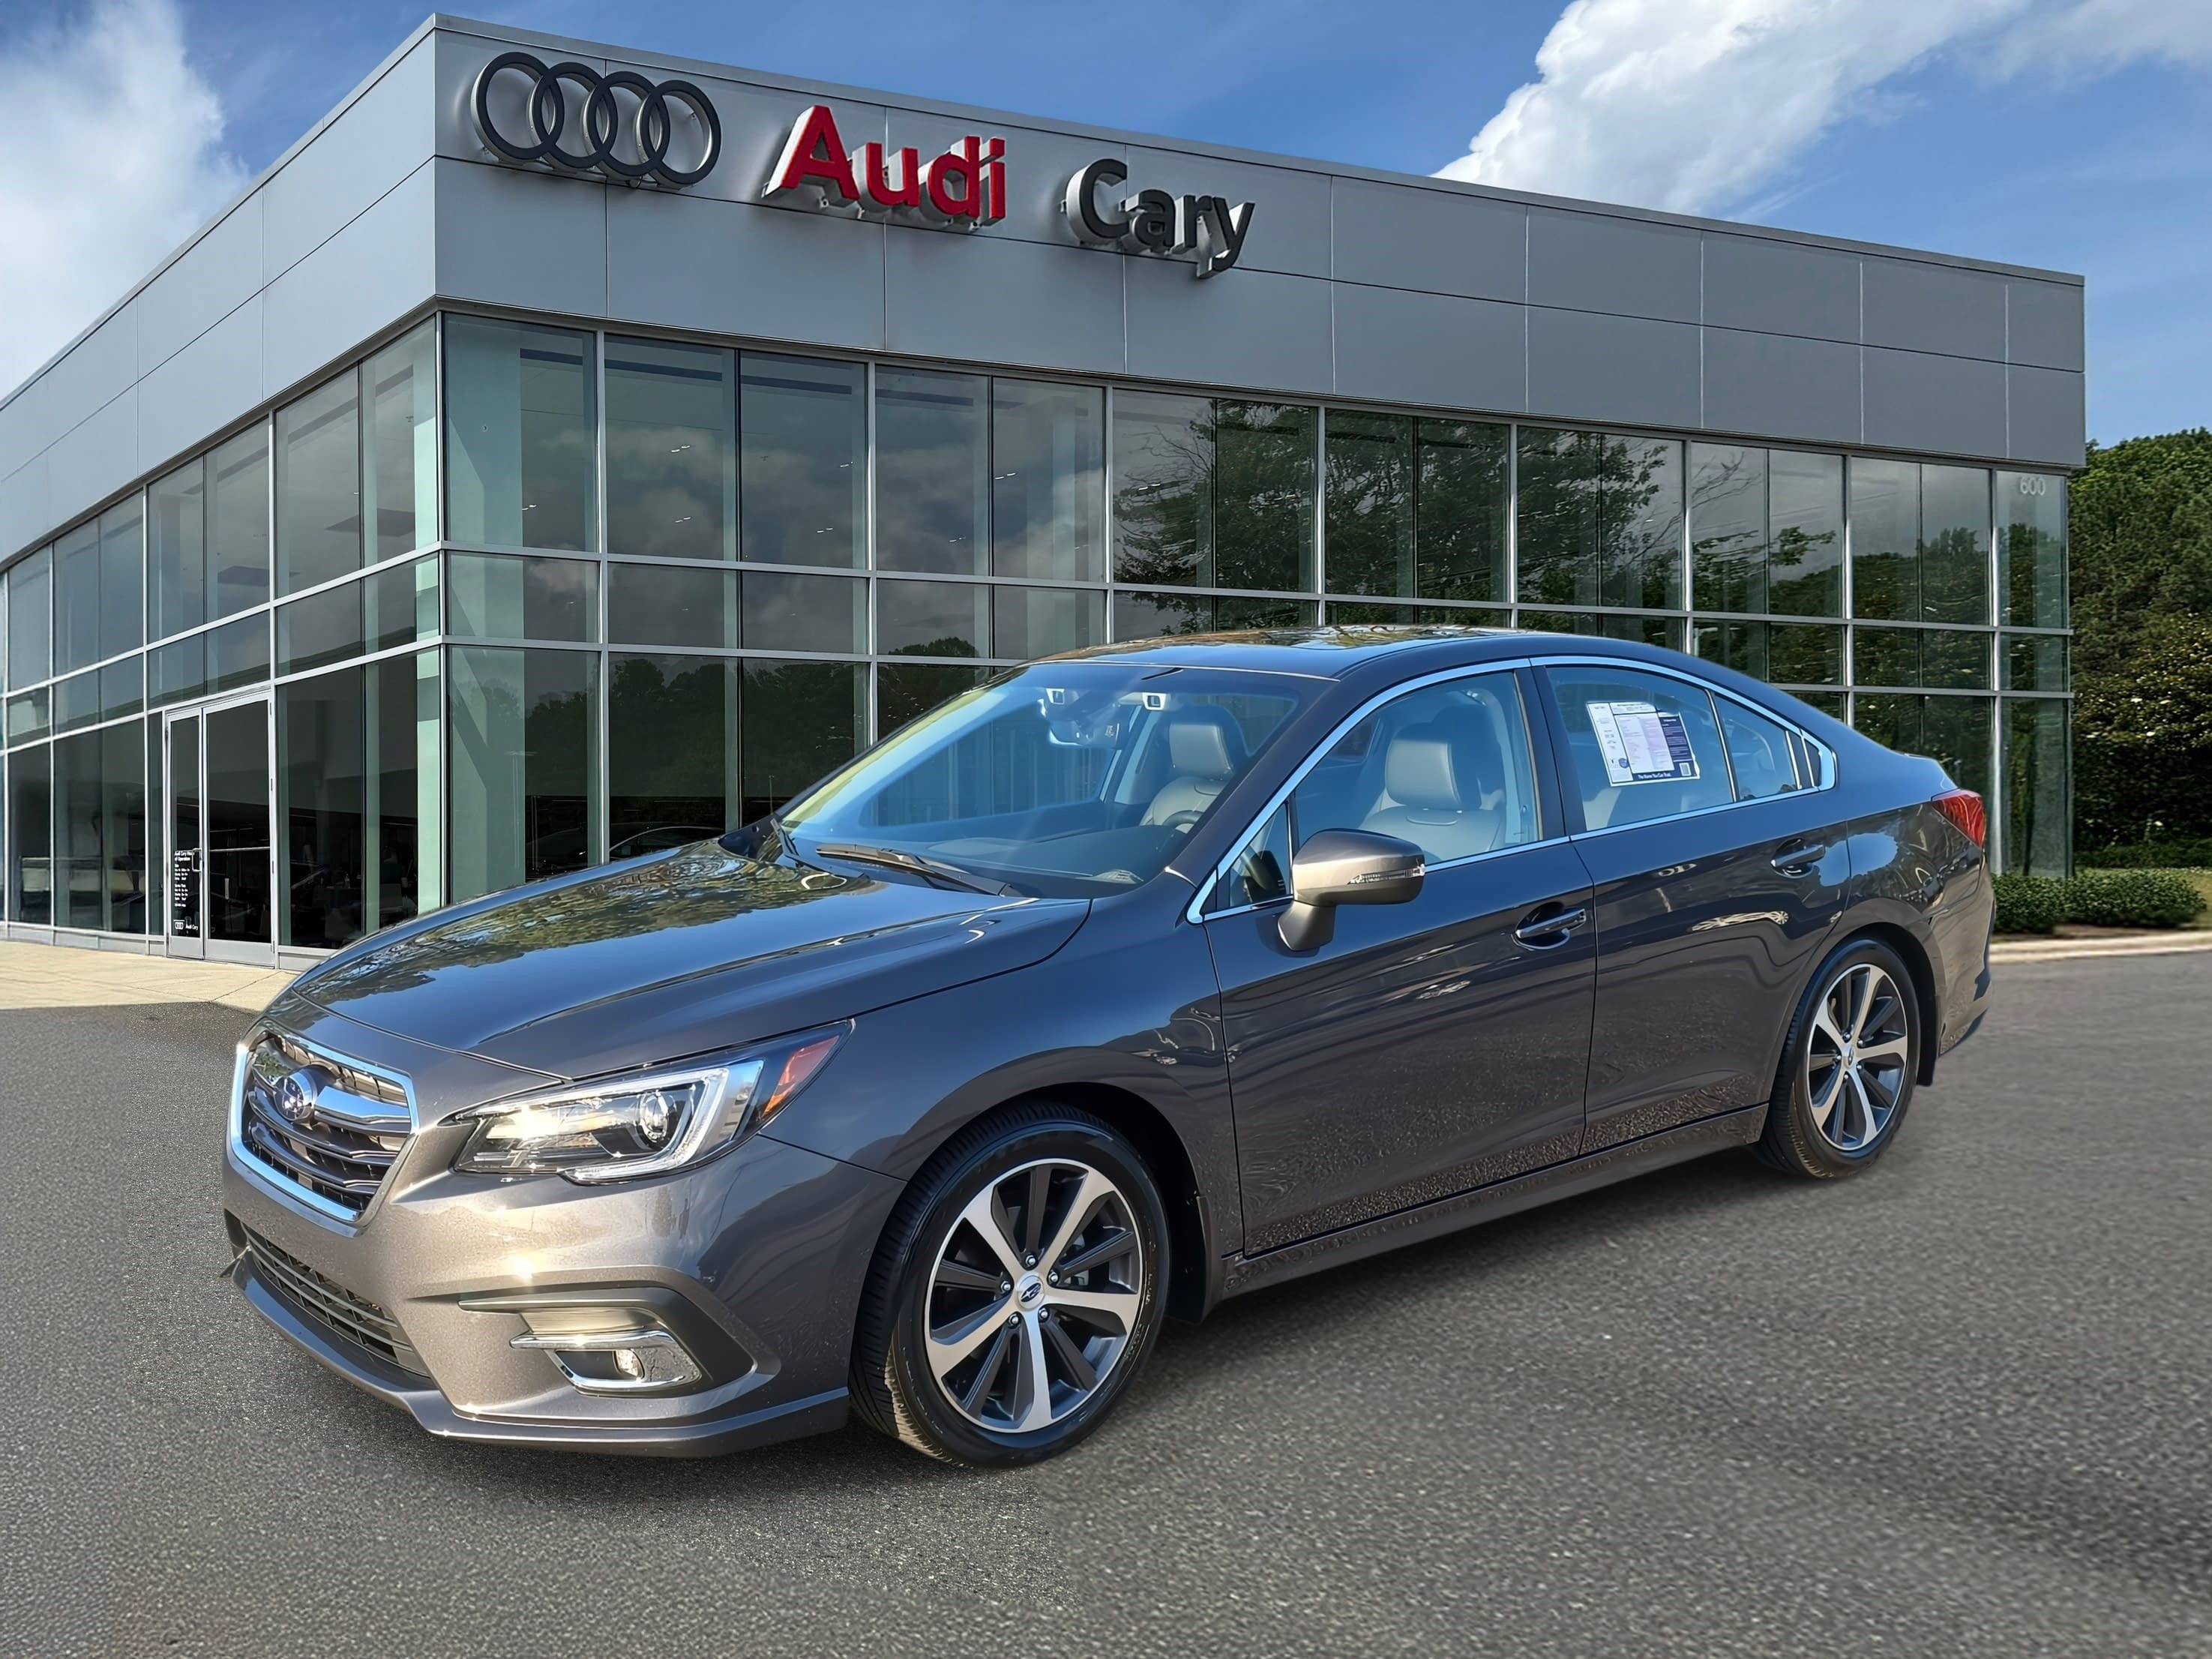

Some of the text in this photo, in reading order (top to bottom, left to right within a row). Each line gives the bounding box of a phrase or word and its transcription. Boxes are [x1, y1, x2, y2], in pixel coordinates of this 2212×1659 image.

[765, 104, 1256, 278] Audi Cary
[2020, 477, 2046, 495] 600
